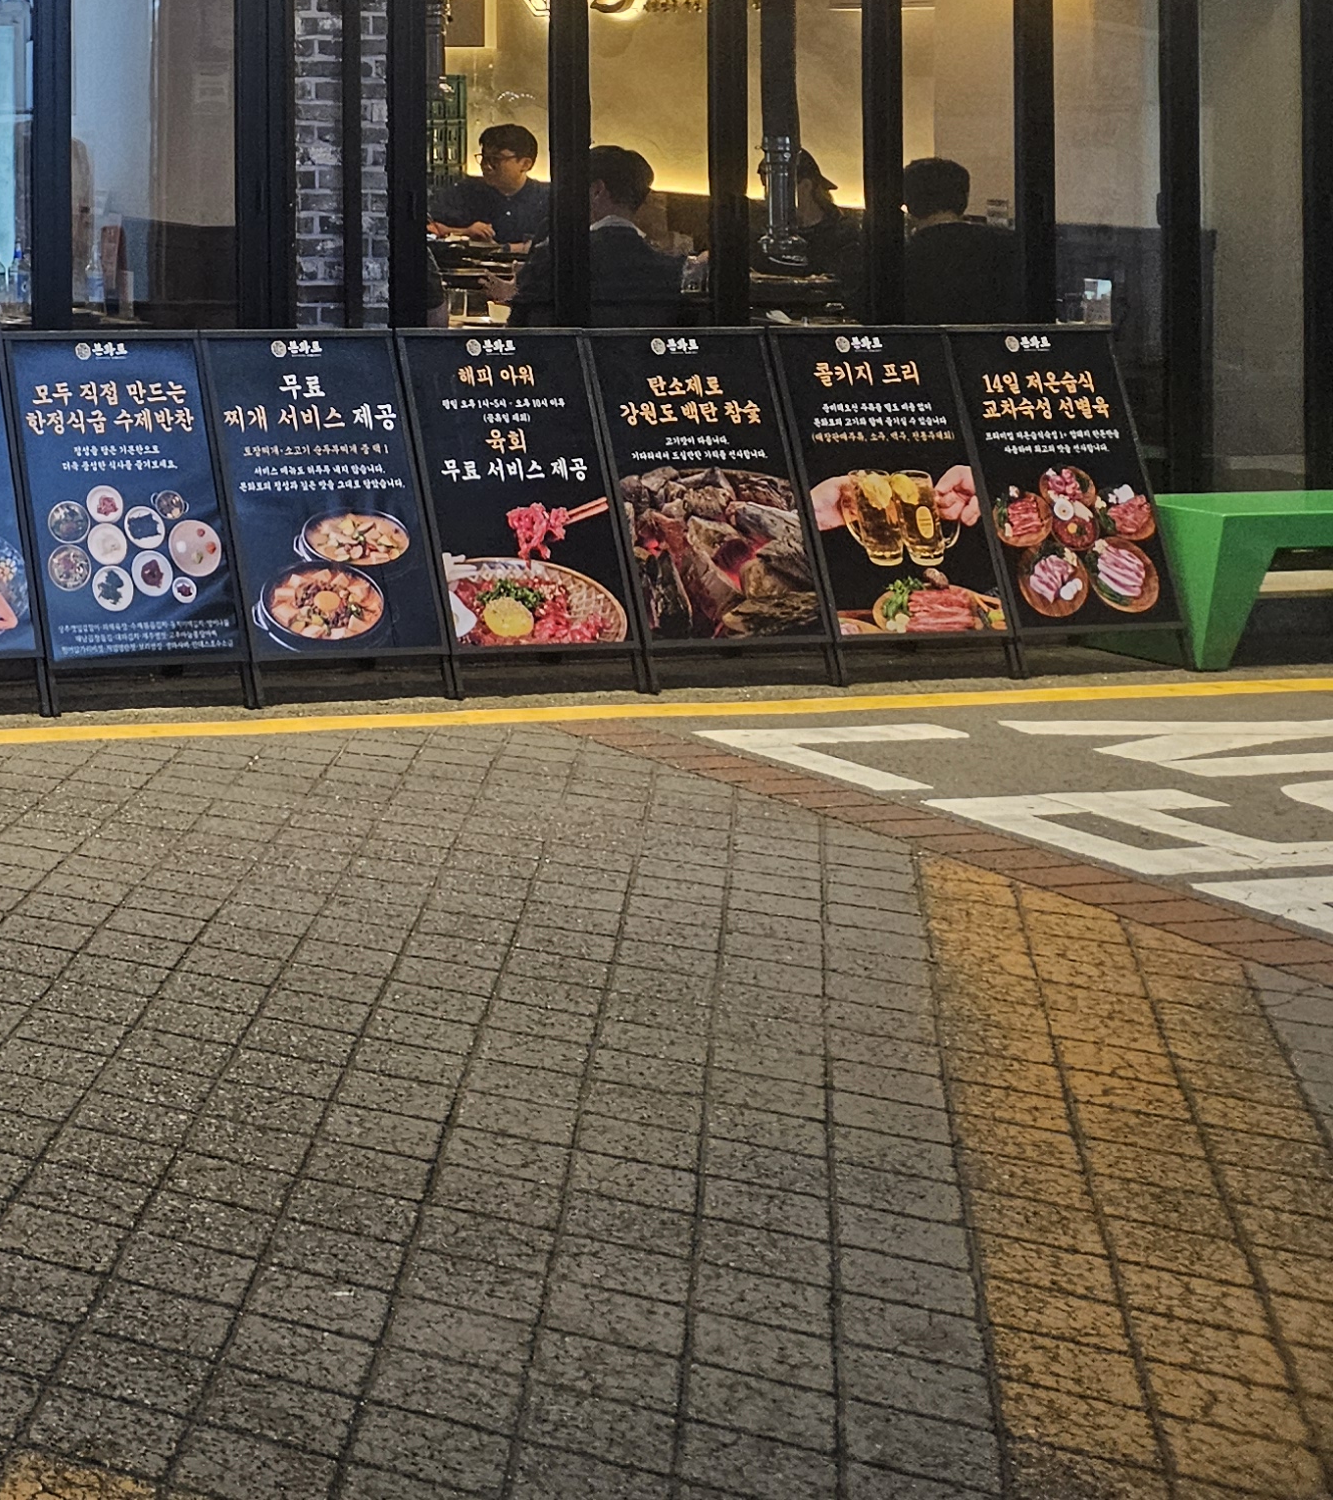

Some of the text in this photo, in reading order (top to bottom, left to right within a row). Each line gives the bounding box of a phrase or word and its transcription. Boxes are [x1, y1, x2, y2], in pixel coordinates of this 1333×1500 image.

[279, 374, 325, 400] 무료
[458, 364, 535, 387] 해피 아워
[647, 374, 723, 398] 탄소제로
[813, 361, 920, 387] 콜키지 프리
[983, 371, 1095, 394] 14일 저온습식
[33, 380, 186, 406] 모두 직접 만드는
[26, 407, 194, 435] 한정식급 수제반찬
[223, 403, 397, 433] 찌개 서비스 제공
[620, 400, 761, 426] 강원도 백탄 참숯
[983, 396, 1109, 420] 교차숙성 선별육
[485, 428, 527, 454] 육회
[441, 457, 587, 482] 무료 서비스 제공
